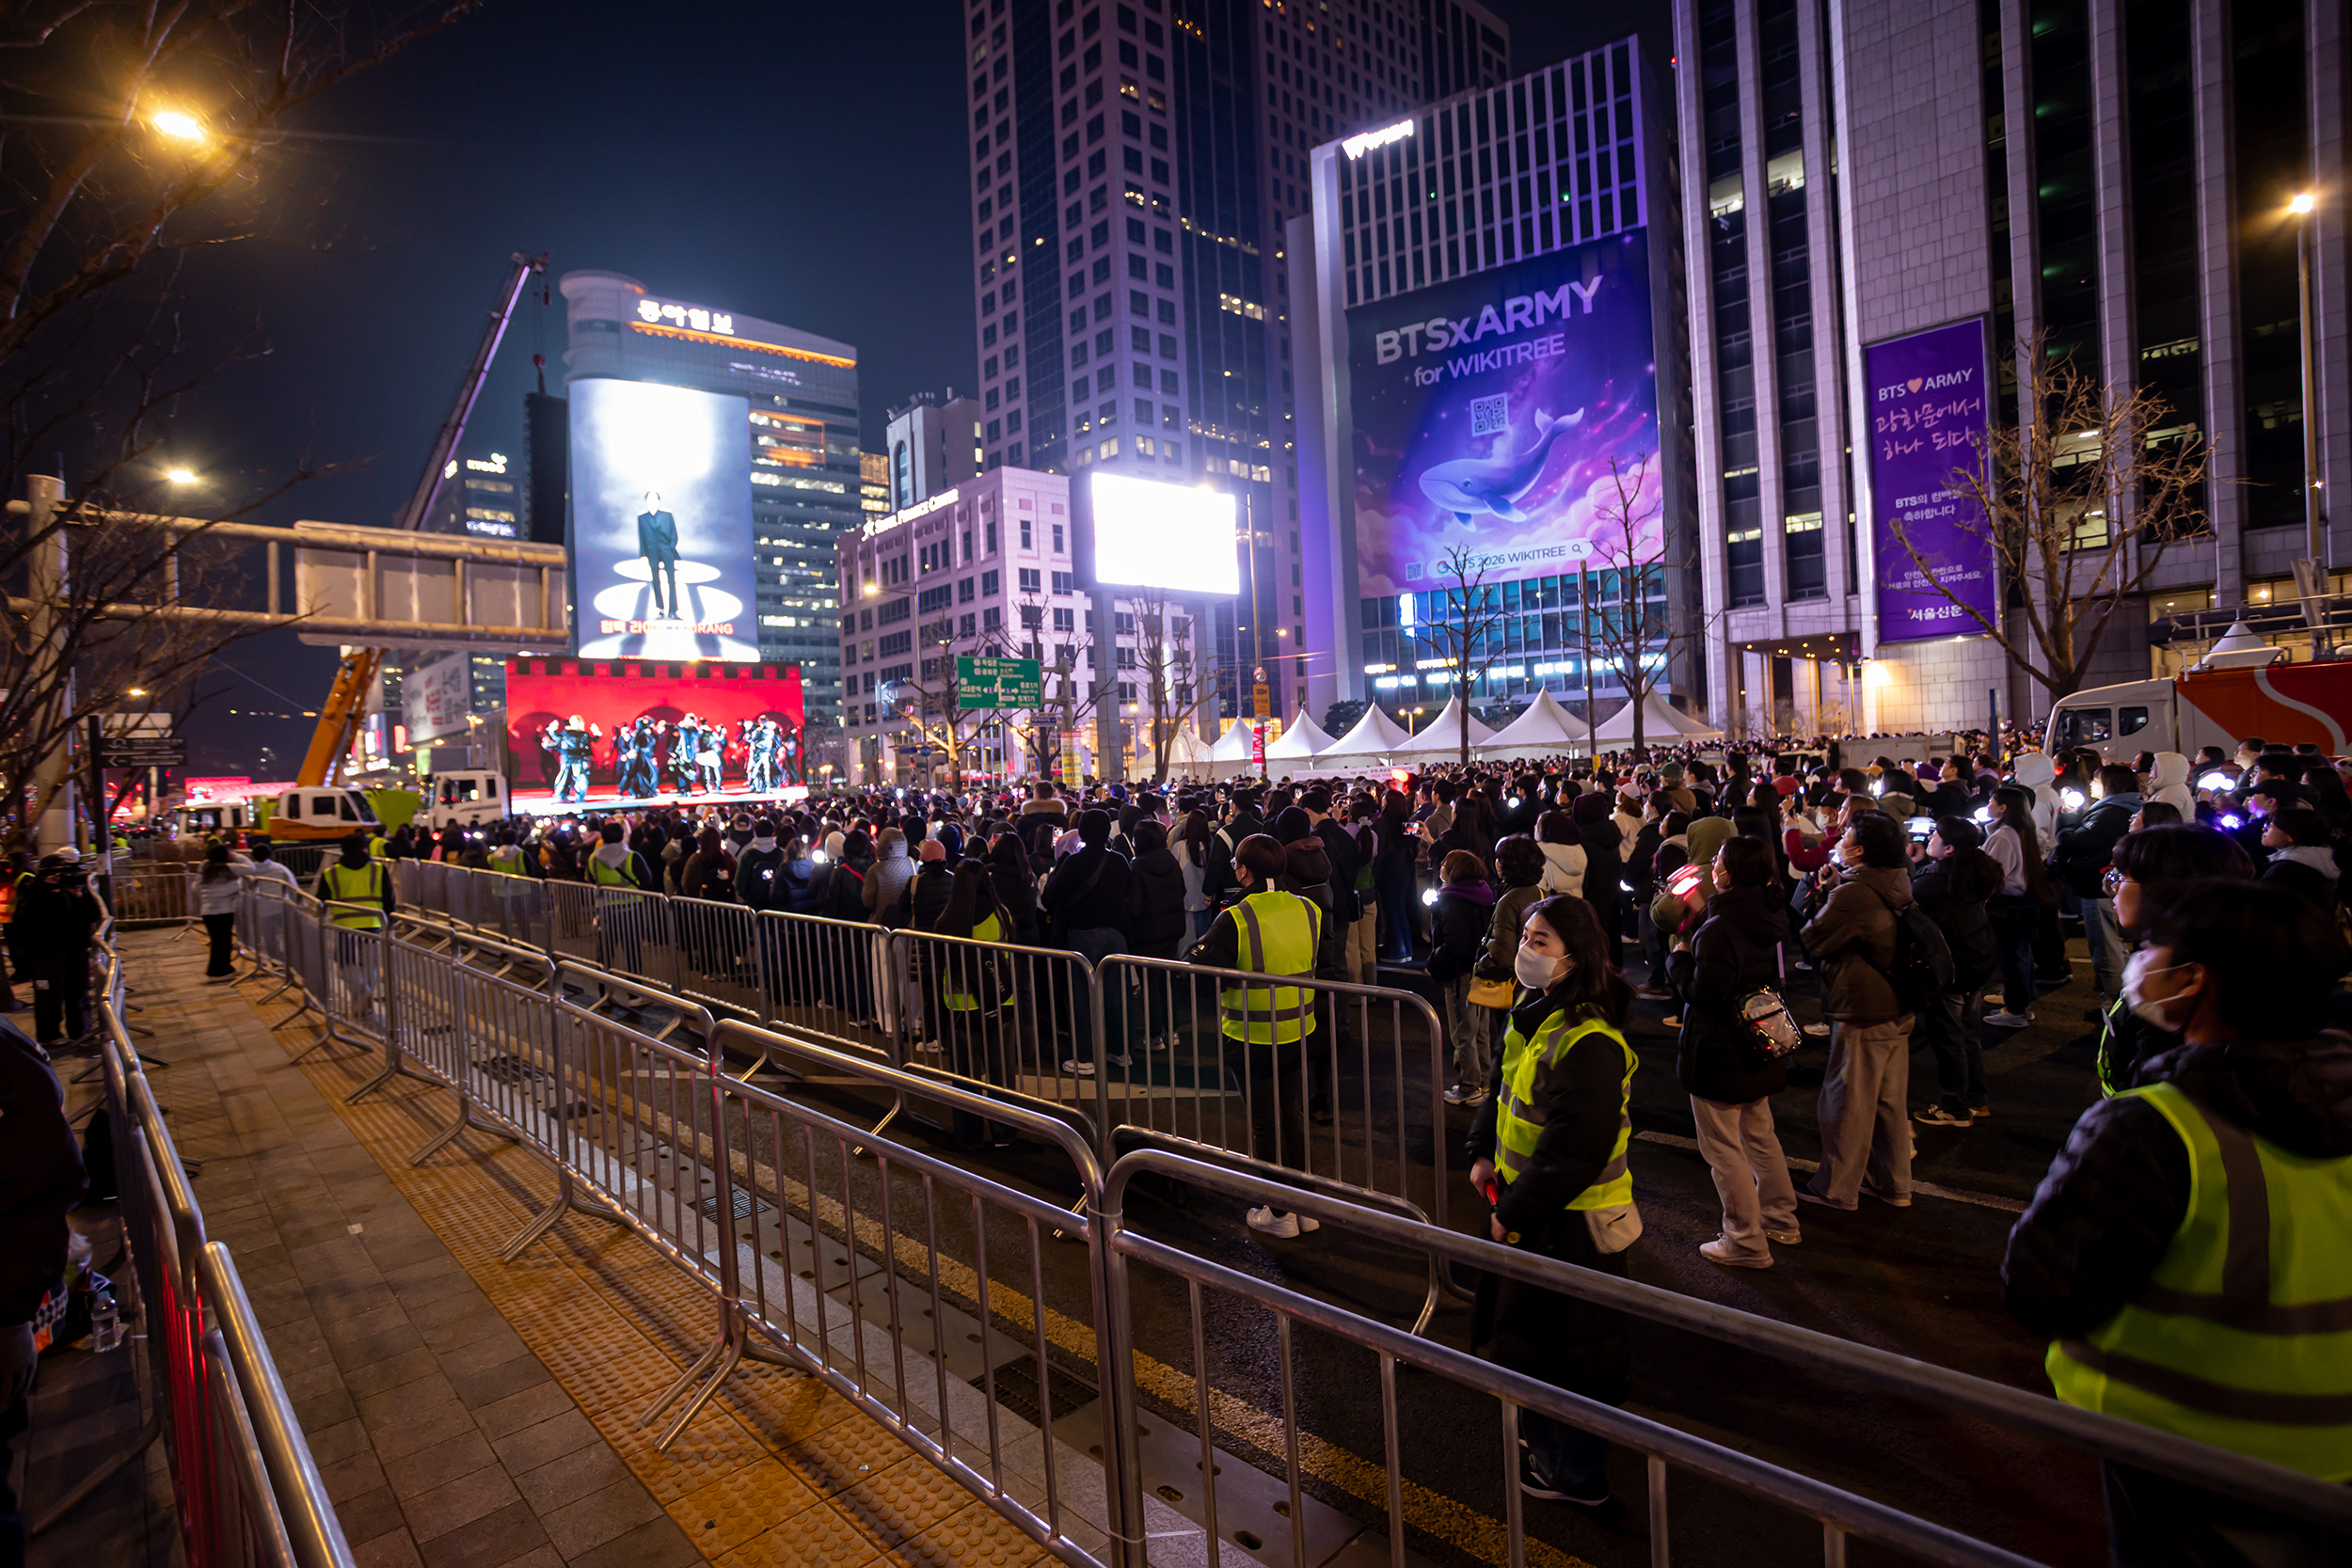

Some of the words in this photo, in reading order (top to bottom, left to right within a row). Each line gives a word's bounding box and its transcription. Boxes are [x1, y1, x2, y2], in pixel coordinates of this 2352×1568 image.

[637, 299, 735, 335] 동아일보
[1375, 275, 1603, 366] BTSxARMY
[1414, 366, 1444, 388] for
[1447, 332, 1566, 379] WIKITREE
[1878, 383, 1906, 402] BTS
[1924, 367, 1973, 391] ARMY
[1875, 397, 1979, 433] 광화문에서
[1883, 437, 1924, 461] 하나
[1931, 425, 1975, 451] 되다
[1895, 494, 1928, 509] BTS의
[1903, 504, 1956, 522] 축하합니다
[1477, 554, 1505, 568] 2026
[1507, 546, 1566, 562] WIKITREE
[1910, 604, 1963, 622] 서울신문
